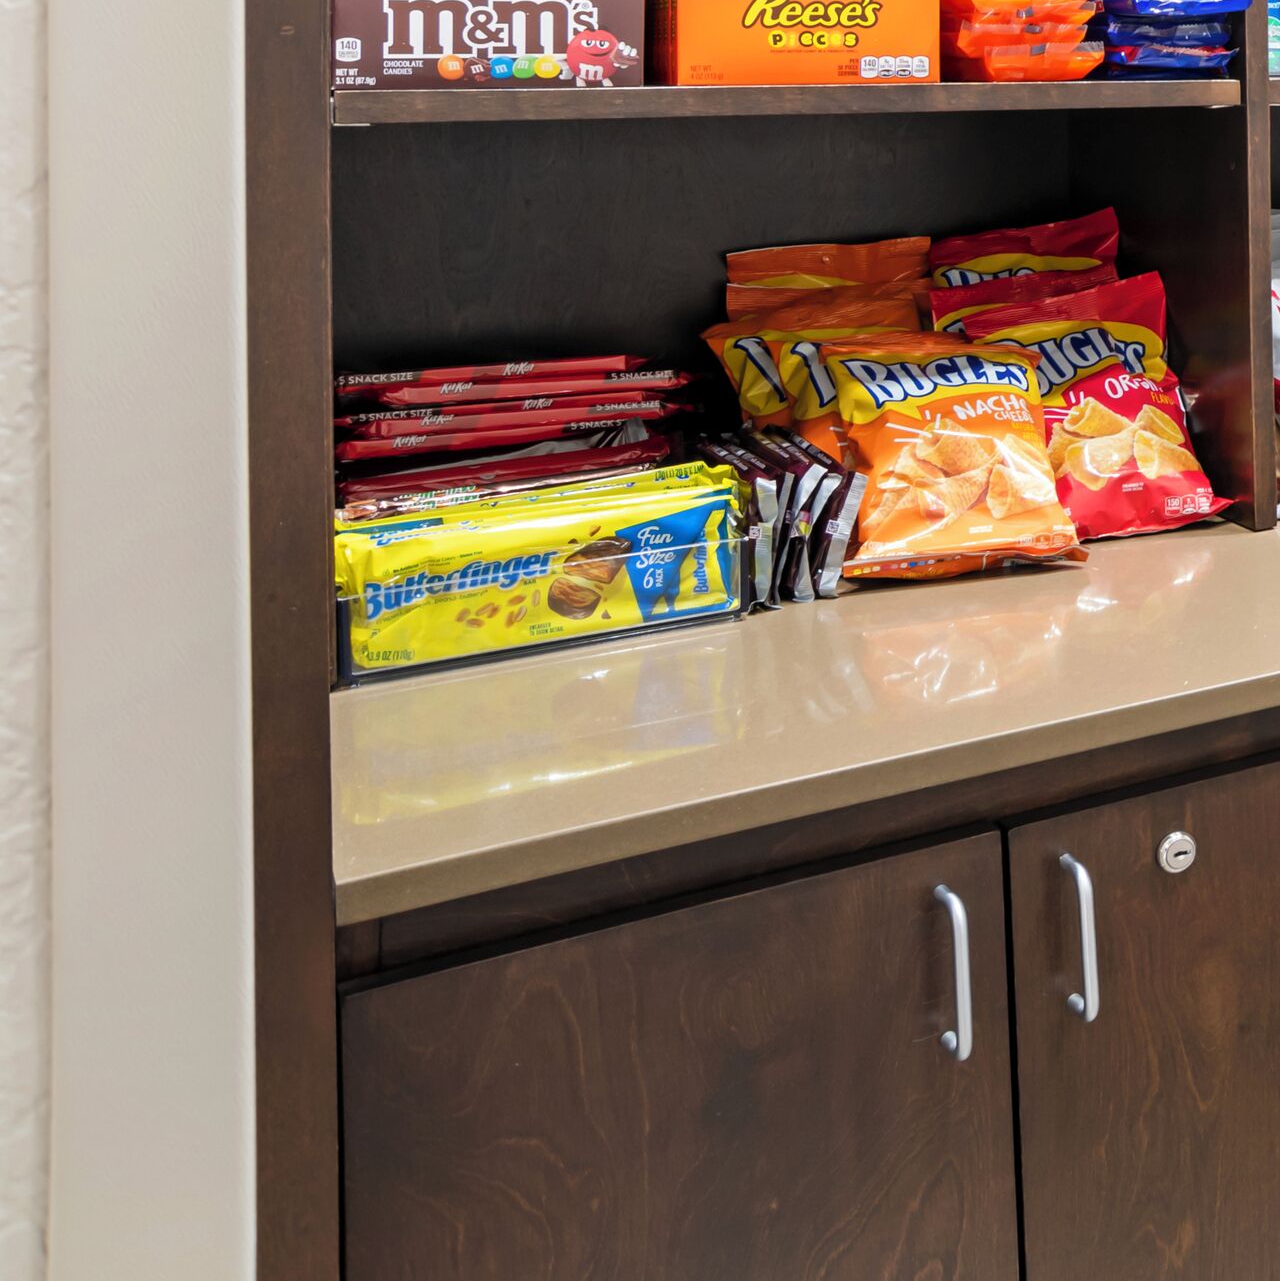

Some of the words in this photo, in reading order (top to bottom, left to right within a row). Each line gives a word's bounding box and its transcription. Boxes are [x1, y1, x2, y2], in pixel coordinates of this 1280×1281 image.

[340, 40, 357, 51] 140
[864, 59, 876, 67] 140
[383, 68, 412, 76] CANDIES
[335, 77, 346, 85] 3.1
[347, 77, 354, 85] OZ
[503, 362, 535, 376] KitKat
[612, 373, 618, 381] 5
[620, 371, 653, 380] SNACK
[654, 369, 675, 379] SIZE
[348, 373, 388, 385] SNACK
[390, 372, 414, 382] SIZE
[839, 355, 1029, 409] BUGLES
[440, 381, 474, 395] KitKat
[523, 398, 554, 410] KitKat
[604, 402, 639, 411] SNACK
[639, 400, 661, 409] SIZE
[359, 413, 366, 421] 5
[367, 411, 407, 421] SNACK
[408, 409, 433, 418] SIZE
[570, 421, 577, 430] 5
[579, 420, 614, 429] SNACK
[393, 435, 427, 448] KitKat
[1167, 498, 1180, 507] 150
[637, 526, 673, 546] Fun
[636, 547, 675, 569] Size
[643, 569, 653, 589] 6
[656, 568, 664, 588] PACK
[365, 551, 559, 622] Butterfinger
